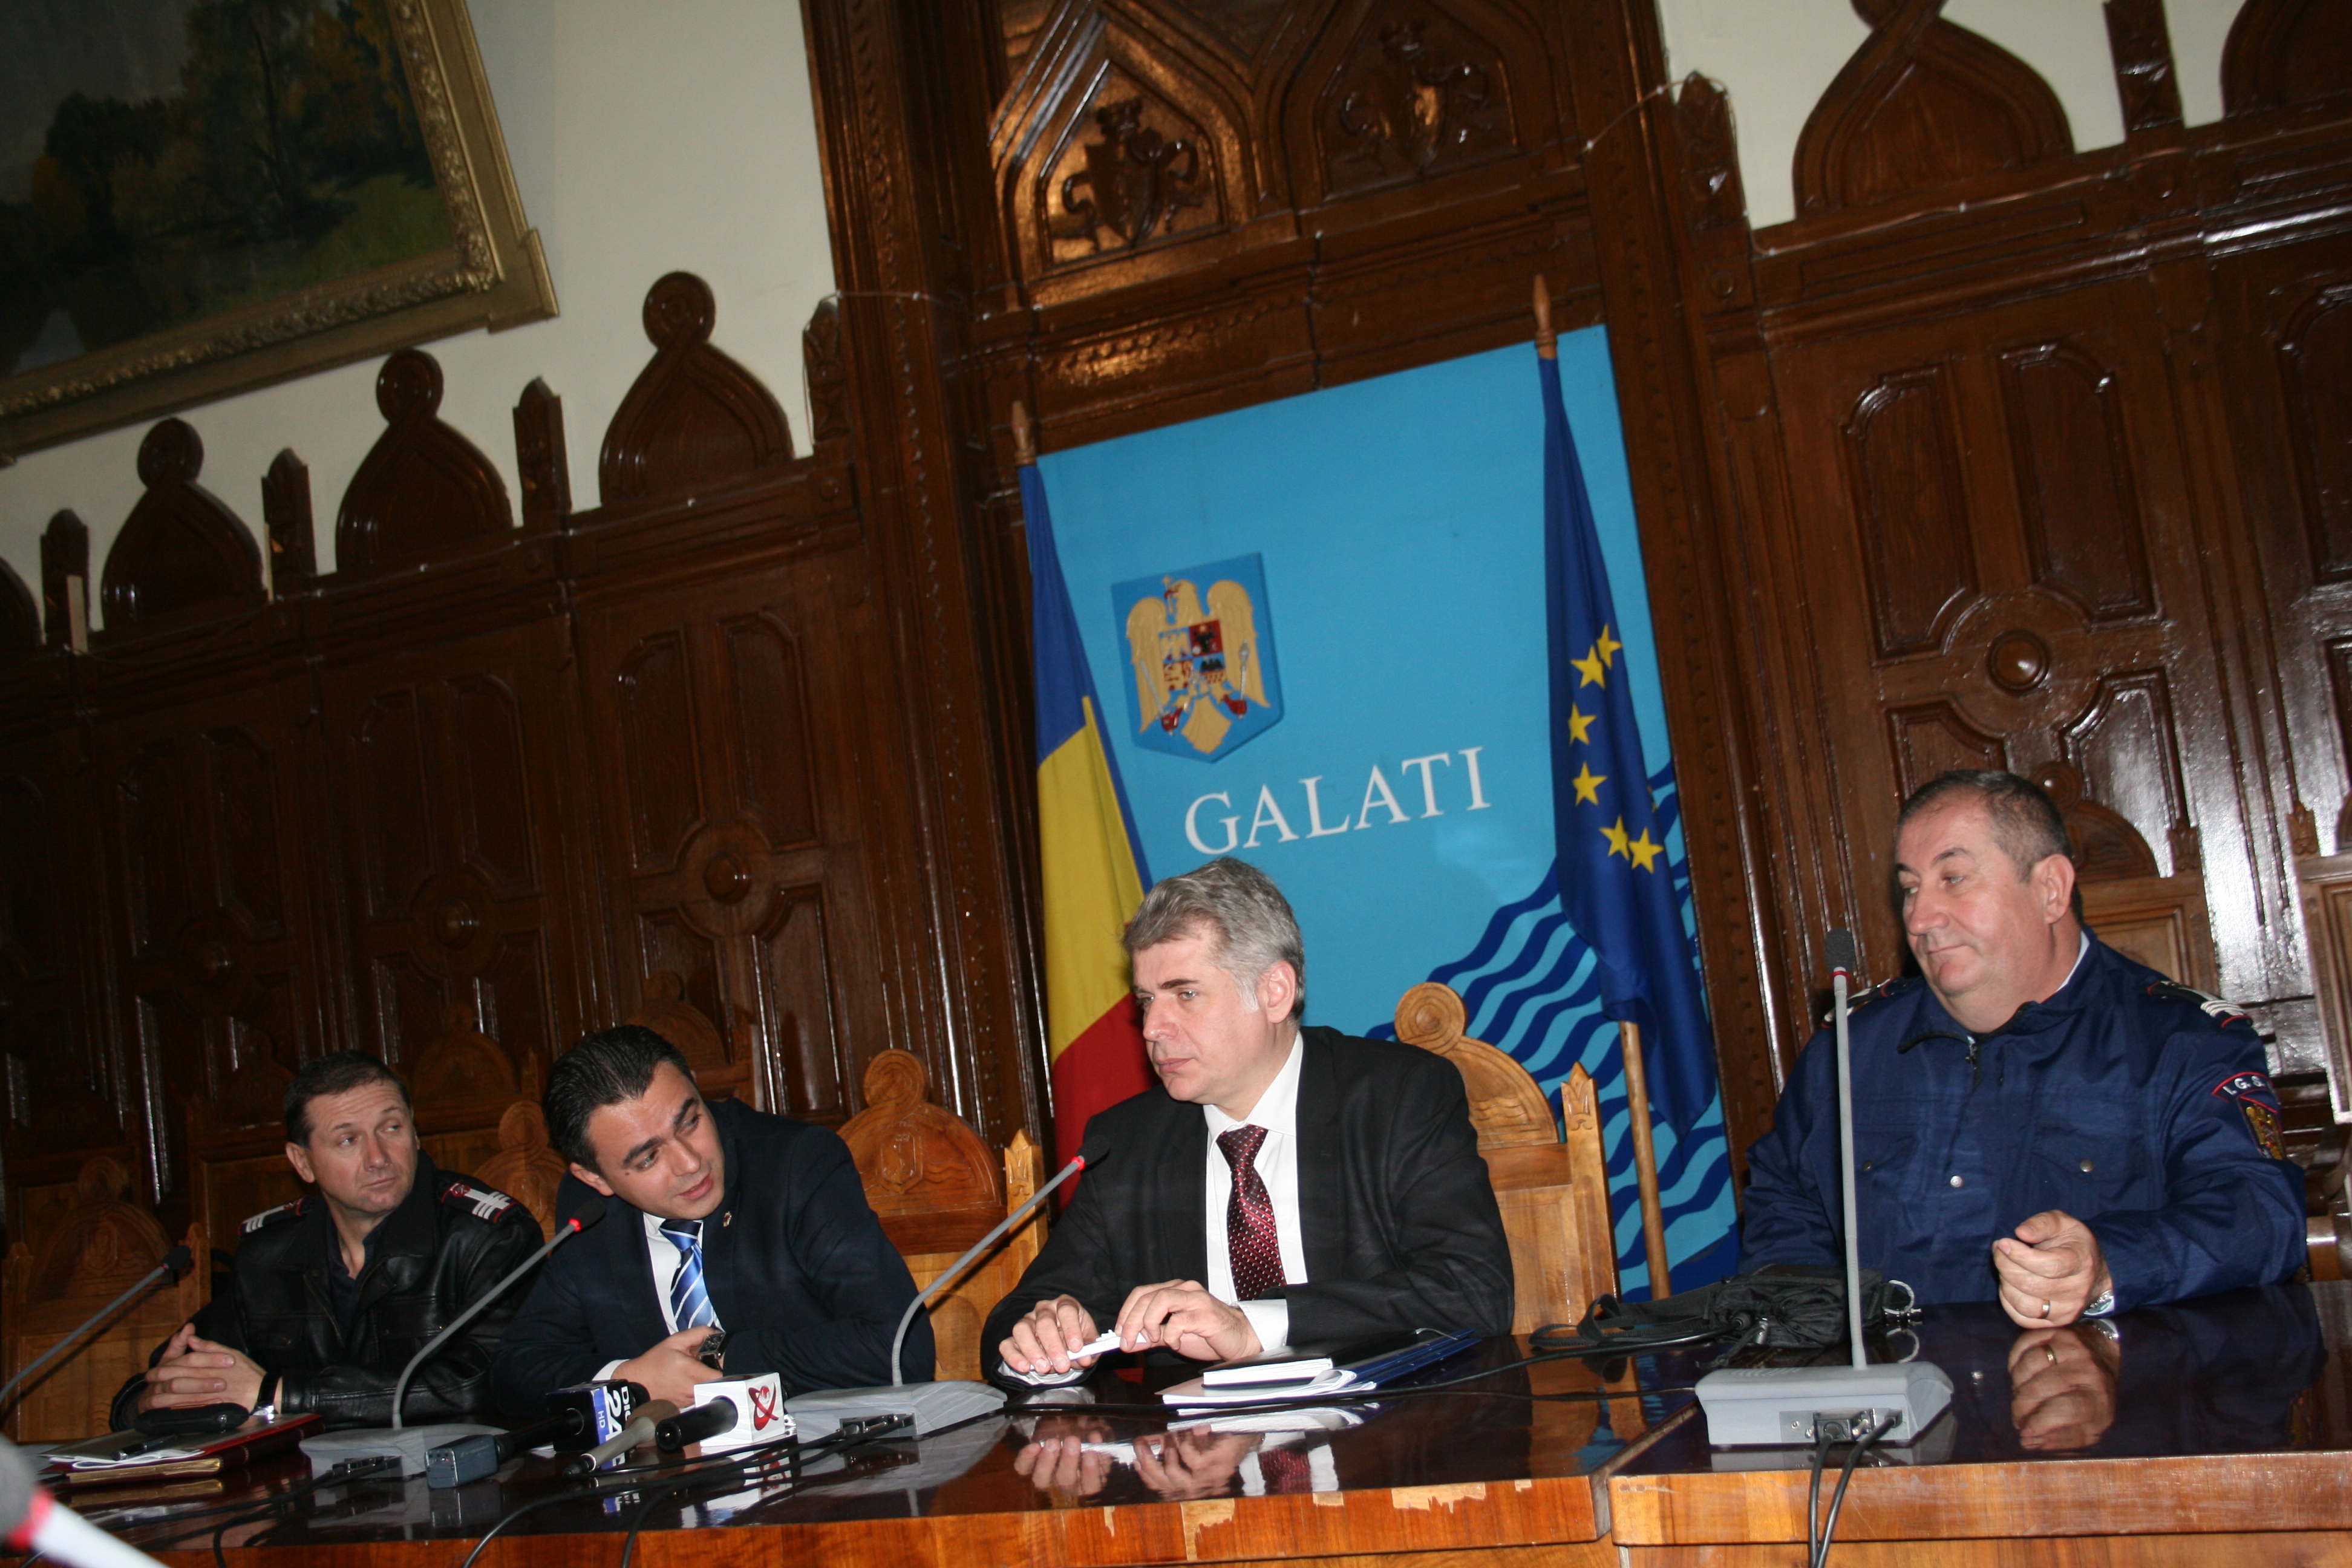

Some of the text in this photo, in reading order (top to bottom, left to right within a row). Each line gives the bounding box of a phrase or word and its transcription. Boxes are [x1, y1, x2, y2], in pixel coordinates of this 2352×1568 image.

[1184, 746, 1492, 855] GALATI
[2222, 1075, 2272, 1096] I.G.S.
[598, 1411, 606, 1428] HD
[604, 1386, 622, 1441] 24
